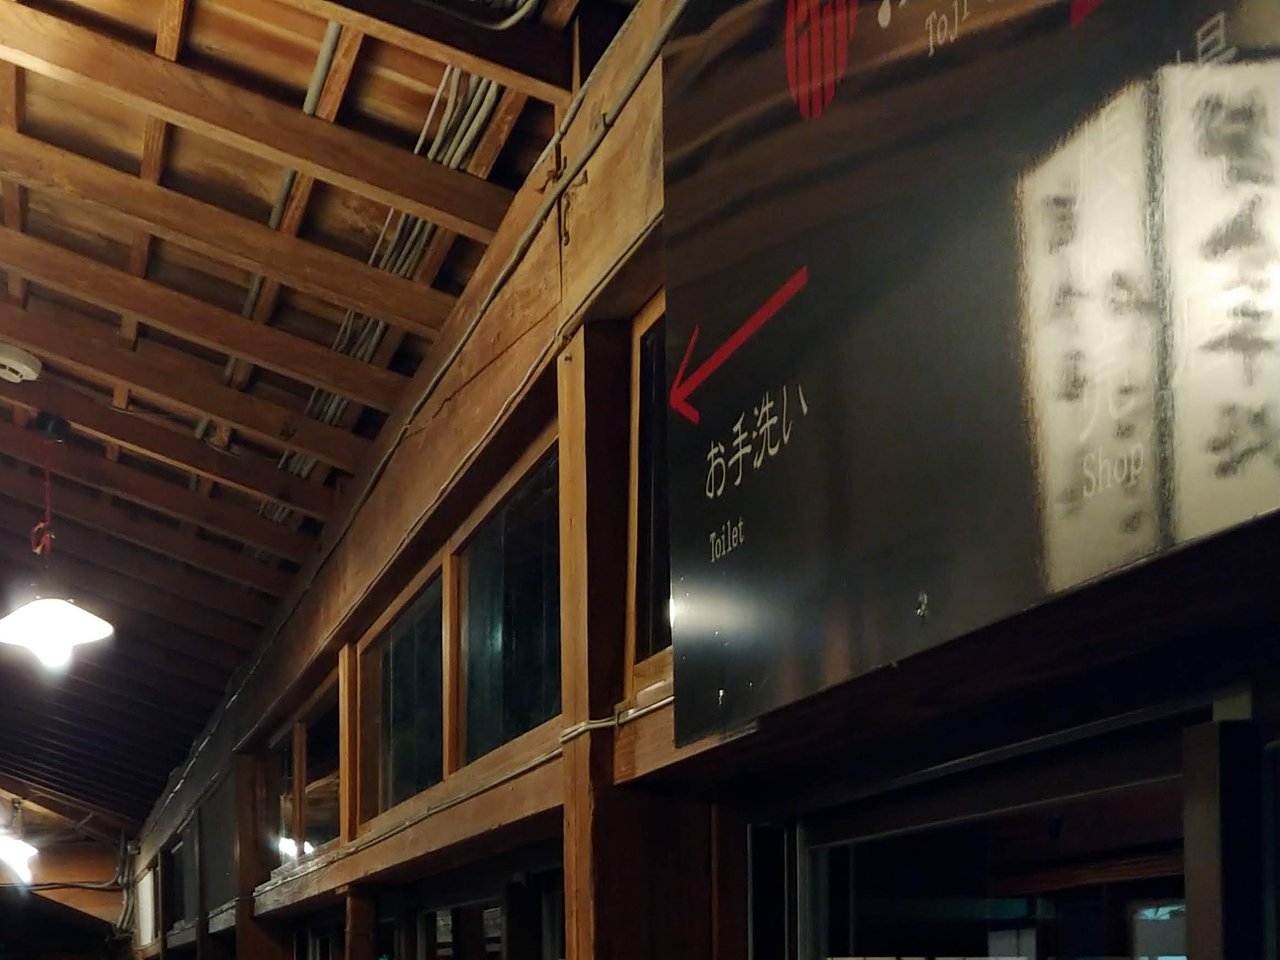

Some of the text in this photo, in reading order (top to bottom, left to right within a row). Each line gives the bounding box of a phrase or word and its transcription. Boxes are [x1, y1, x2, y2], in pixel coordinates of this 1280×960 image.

[705, 384, 808, 499] お手洗い
[1082, 443, 1144, 498] Shop
[709, 515, 745, 563] Toilet
